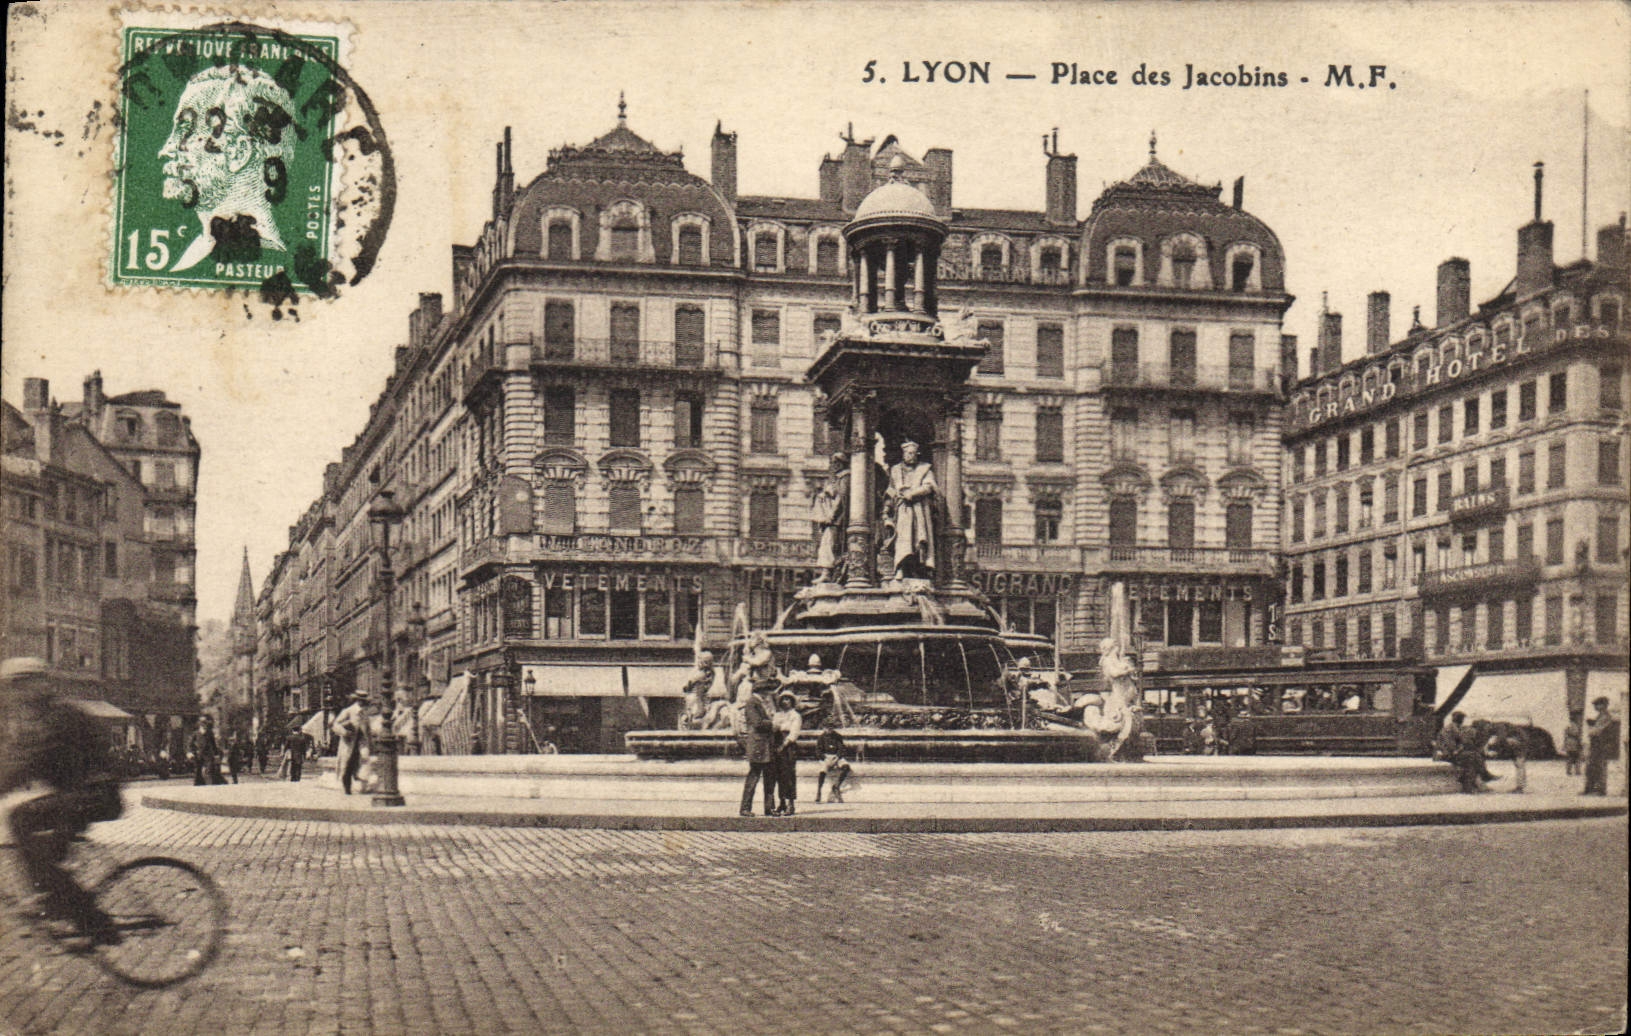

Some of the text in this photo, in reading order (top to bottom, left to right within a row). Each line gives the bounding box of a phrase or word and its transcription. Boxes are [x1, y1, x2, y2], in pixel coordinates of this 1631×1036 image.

[125, 228, 171, 271] 15
[1308, 324, 1610, 424] GRAND HOTEL DES
[544, 572, 704, 593] VETEMENTS
[972, 572, 1072, 596] SIGRAND
[1114, 582, 1253, 601] ETEMENTS
